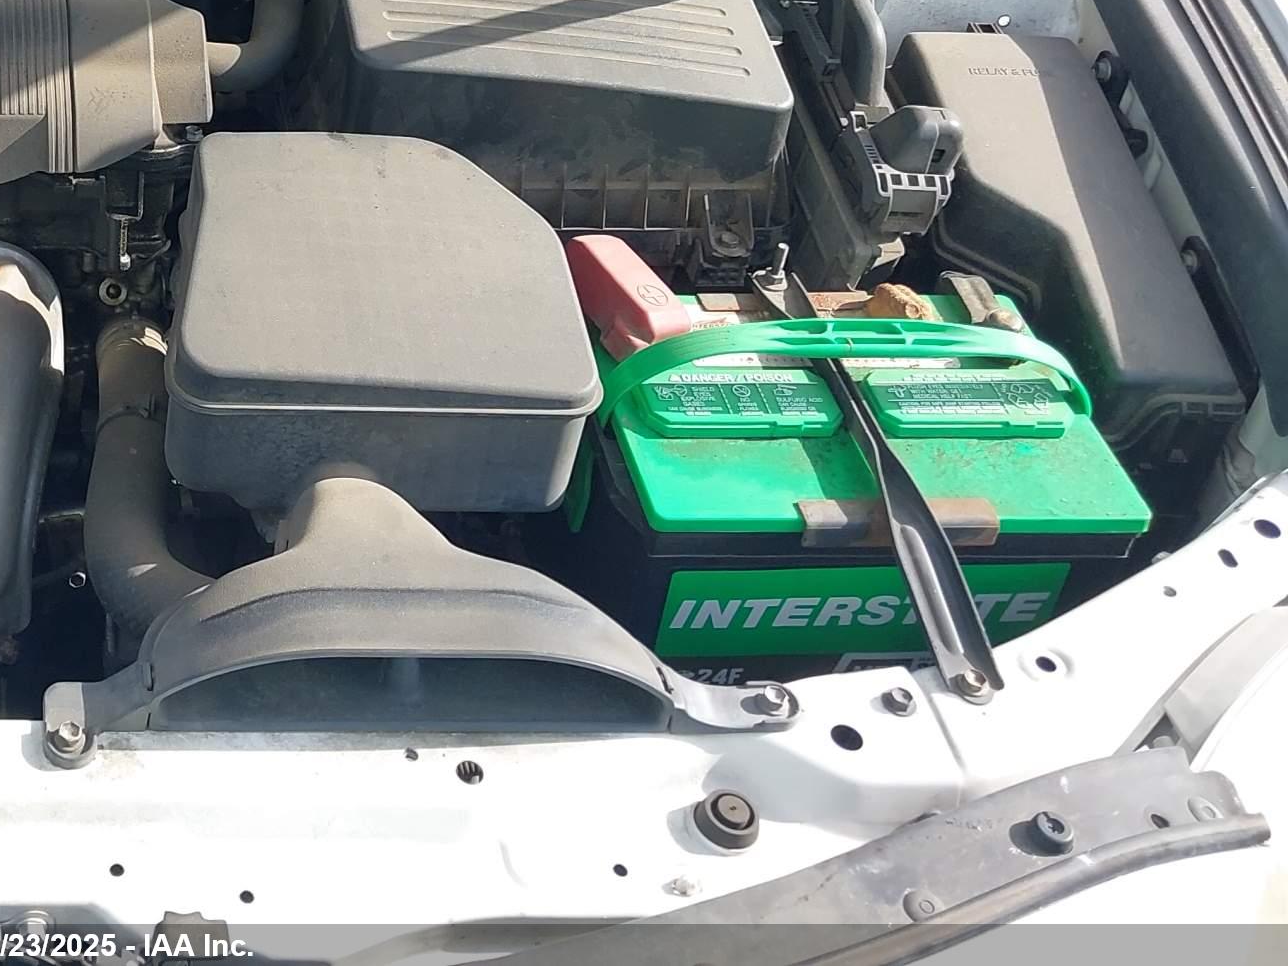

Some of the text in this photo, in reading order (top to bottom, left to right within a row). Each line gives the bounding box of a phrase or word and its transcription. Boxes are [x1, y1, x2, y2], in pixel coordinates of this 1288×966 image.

[967, 67, 1008, 76] RELAY
[1011, 68, 1021, 76] &
[680, 374, 732, 382] DANGER
[743, 374, 793, 382] POISON
[669, 592, 1050, 629] INTERSTE
[697, 667, 744, 685] 24F
